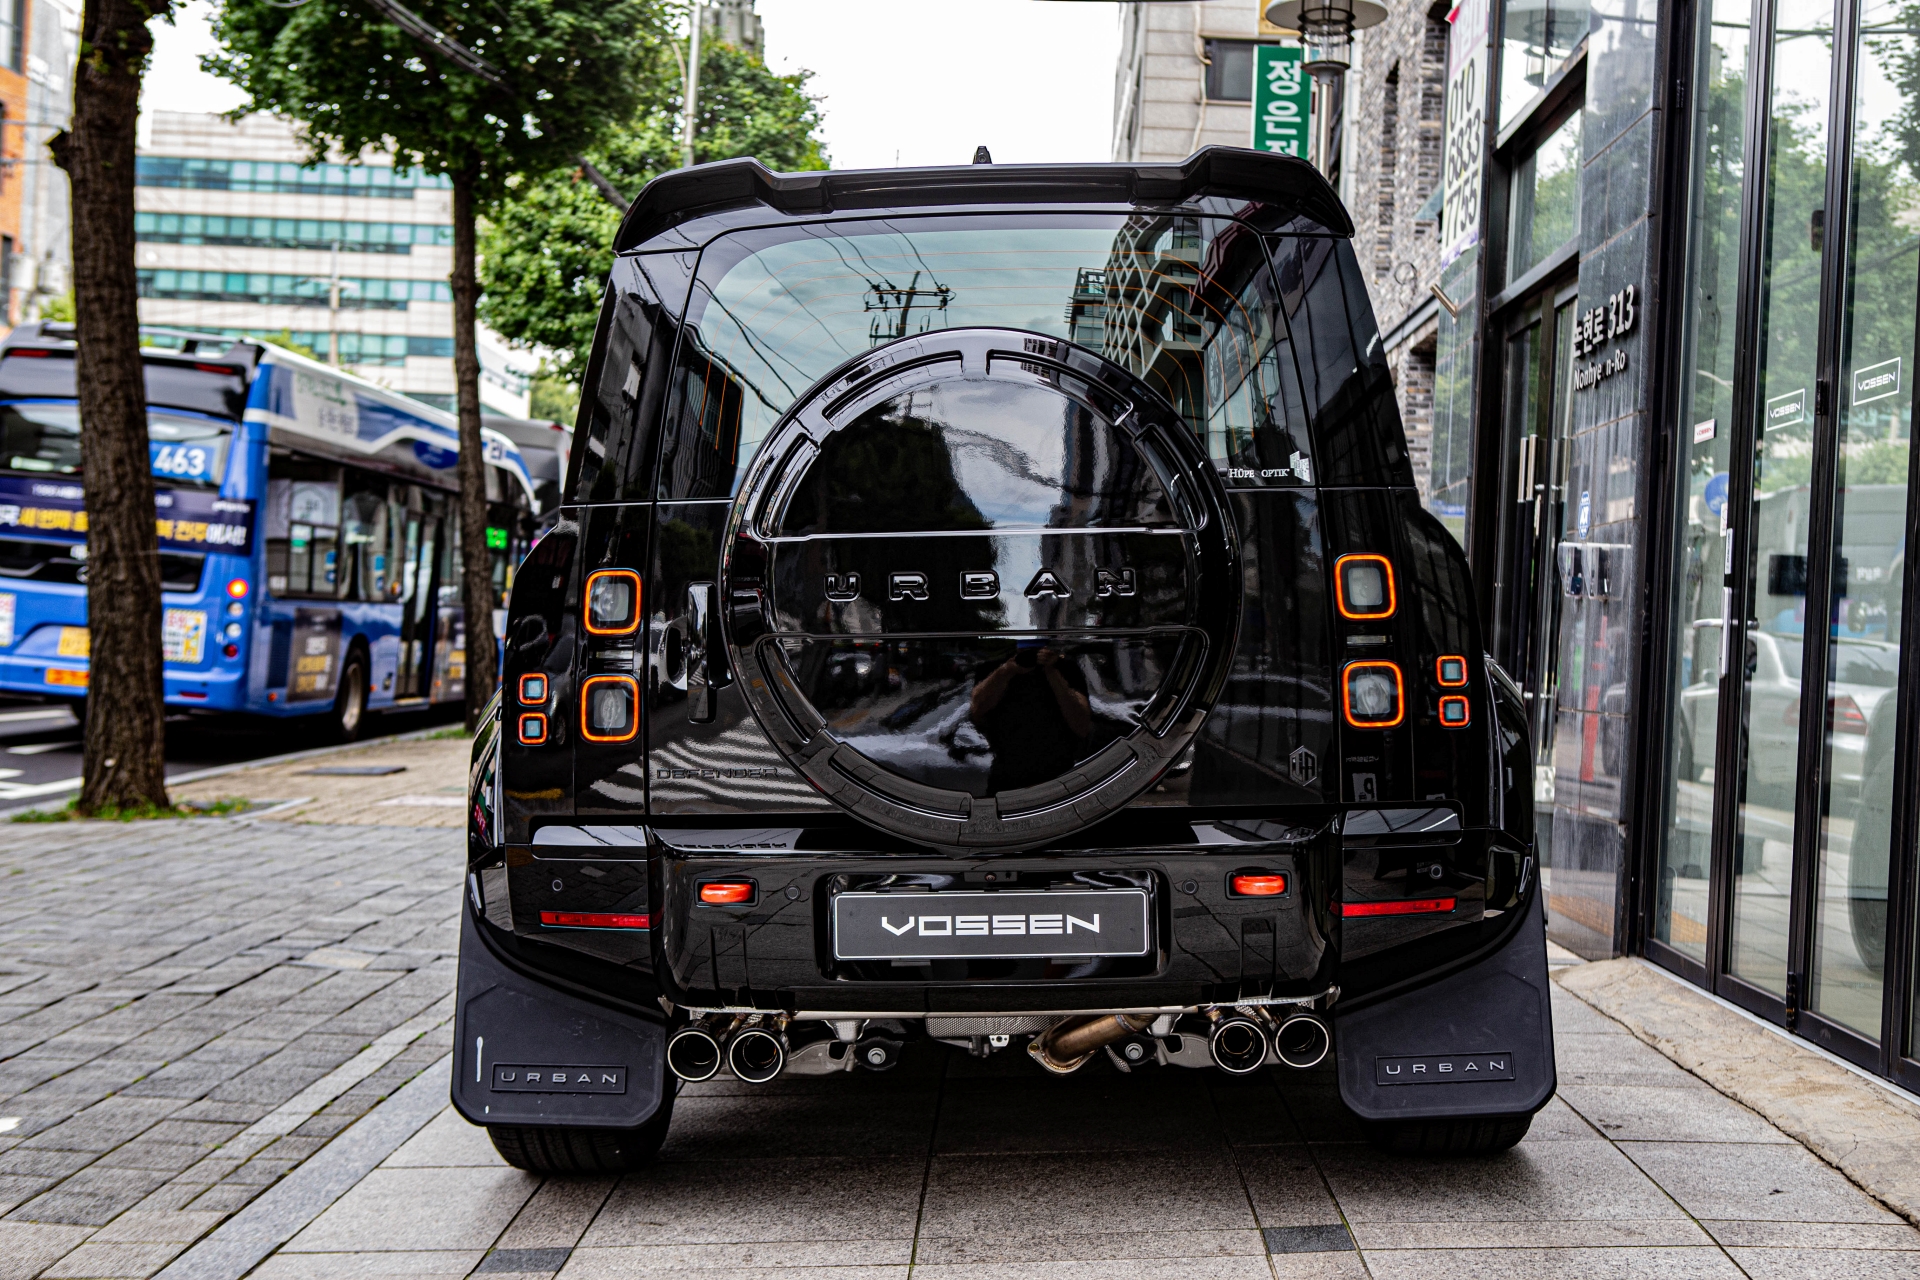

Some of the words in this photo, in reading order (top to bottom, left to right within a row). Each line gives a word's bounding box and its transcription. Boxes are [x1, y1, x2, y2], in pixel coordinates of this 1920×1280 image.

[1450, 57, 1475, 133] 010
[1447, 107, 1481, 190] 6833
[1446, 167, 1479, 248] 7755
[1608, 283, 1634, 339] 313
[1858, 372, 1895, 391] VOSSEN
[1769, 400, 1801, 419] VOSSEN
[153, 445, 206, 477] 463
[824, 567, 1137, 602] URBAN
[656, 767, 779, 780] DEFENDER
[881, 913, 1100, 936] VOSSEN
[501, 1072, 617, 1084] URBAN
[1386, 1060, 1505, 1075] URBAN
